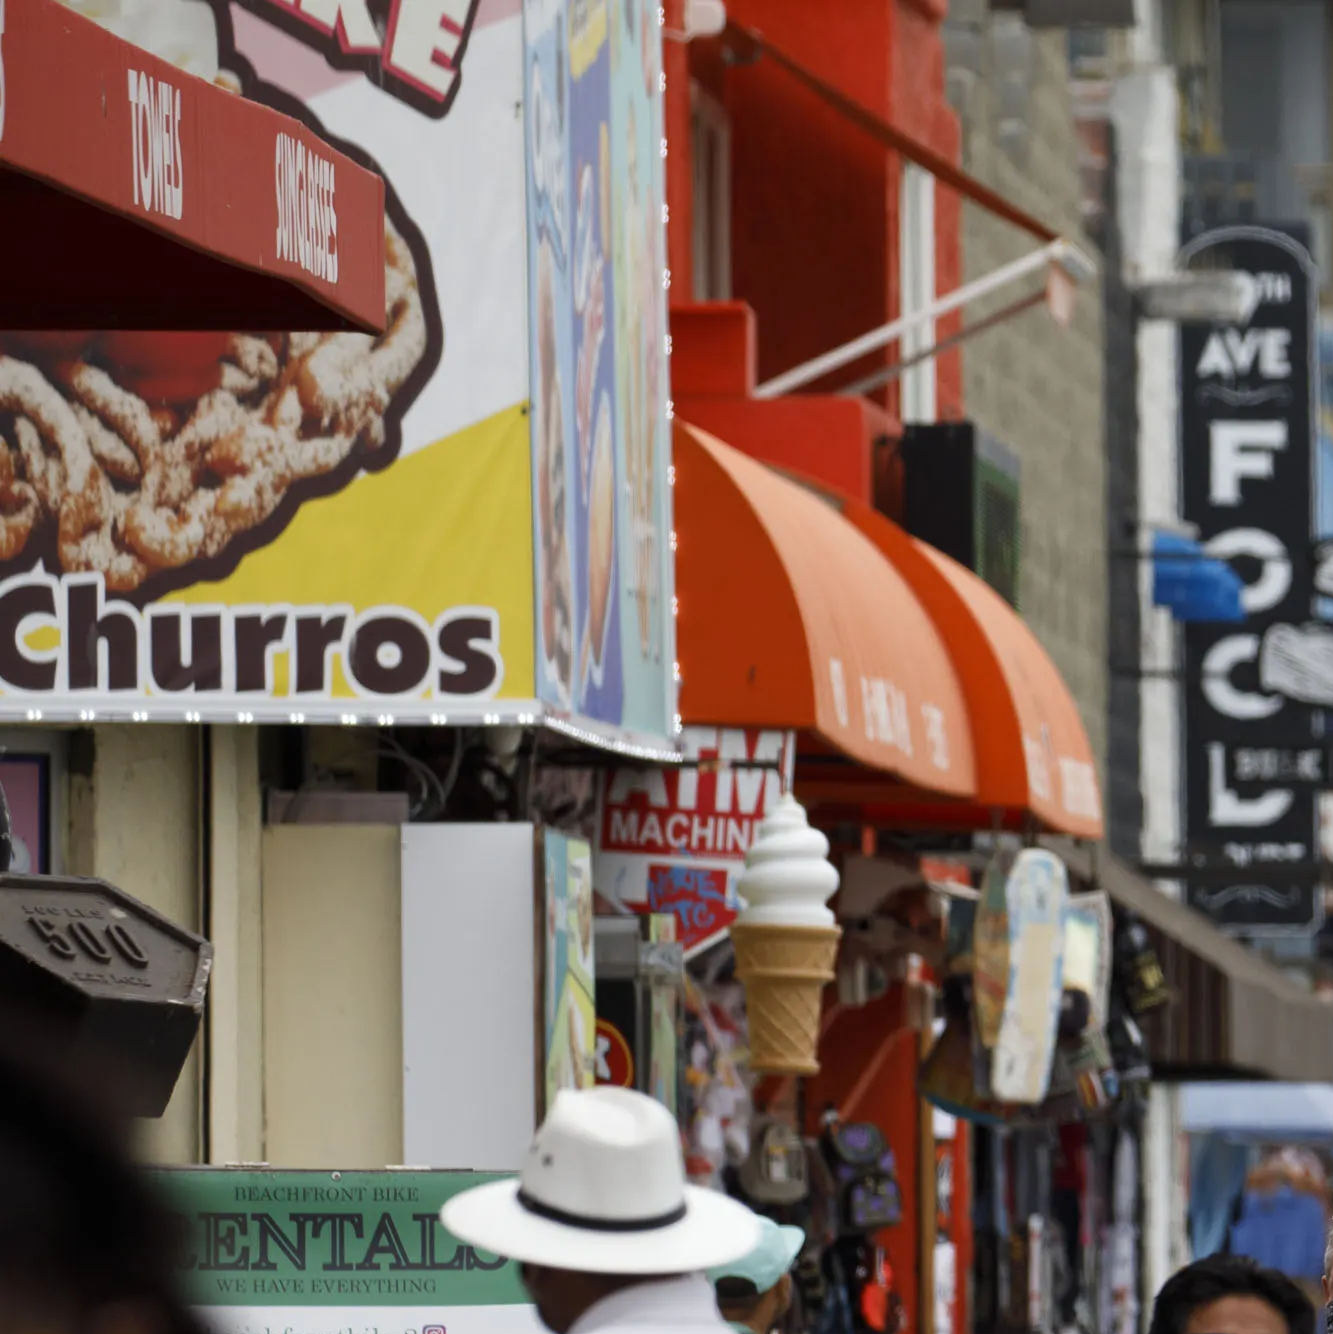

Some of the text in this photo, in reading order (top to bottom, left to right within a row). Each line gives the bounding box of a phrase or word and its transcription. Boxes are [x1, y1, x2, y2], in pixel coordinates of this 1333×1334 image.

[127, 68, 182, 221] TOWELS
[275, 131, 338, 285] SUNGLASSES
[1197, 326, 1291, 379] AVE
[0, 583, 498, 694] Churros
[607, 729, 786, 816] ATM
[27, 917, 148, 969] 500
[234, 1186, 419, 1202] BEACHFRONT BIKE
[216, 1279, 437, 1295] WE HAVE EVERYTHING
